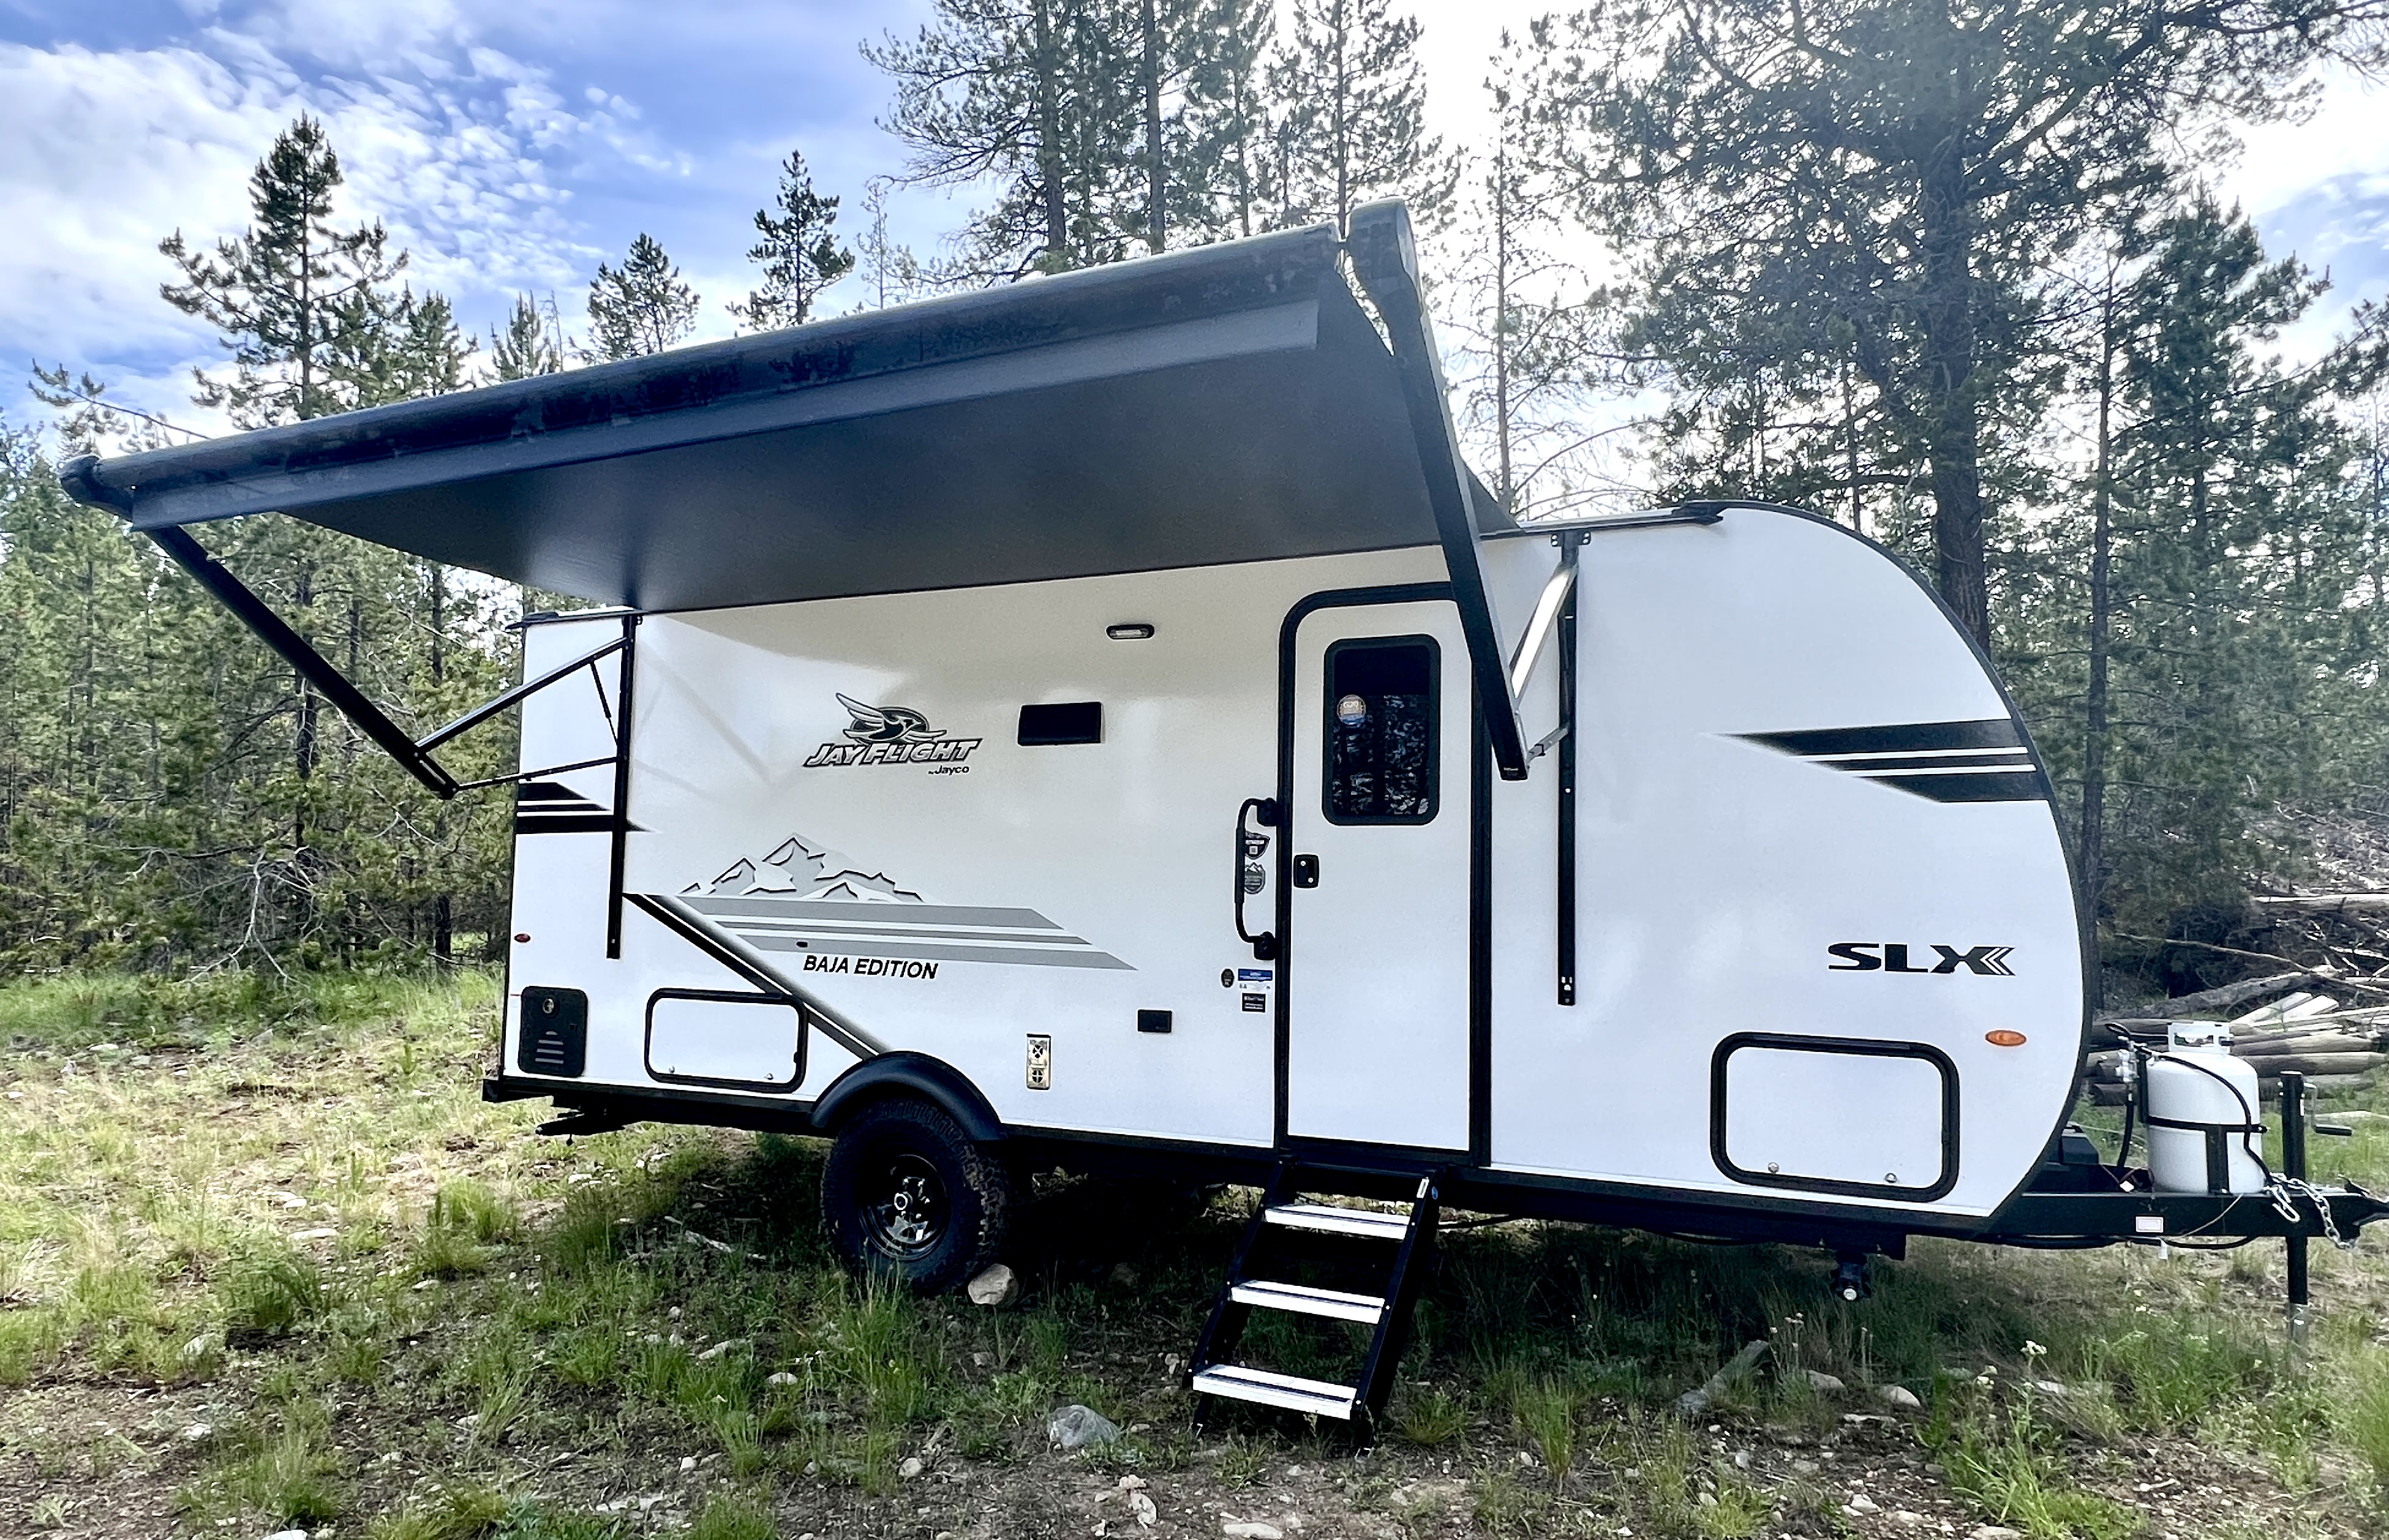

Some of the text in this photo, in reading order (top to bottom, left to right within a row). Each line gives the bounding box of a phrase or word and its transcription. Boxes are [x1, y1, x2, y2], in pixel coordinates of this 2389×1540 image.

[803, 738, 983, 767] JAY FLIGHT
[935, 765, 969, 776] Jayco
[803, 955, 939, 979] BAJA EDITION
[1827, 943, 2016, 976] SLX
